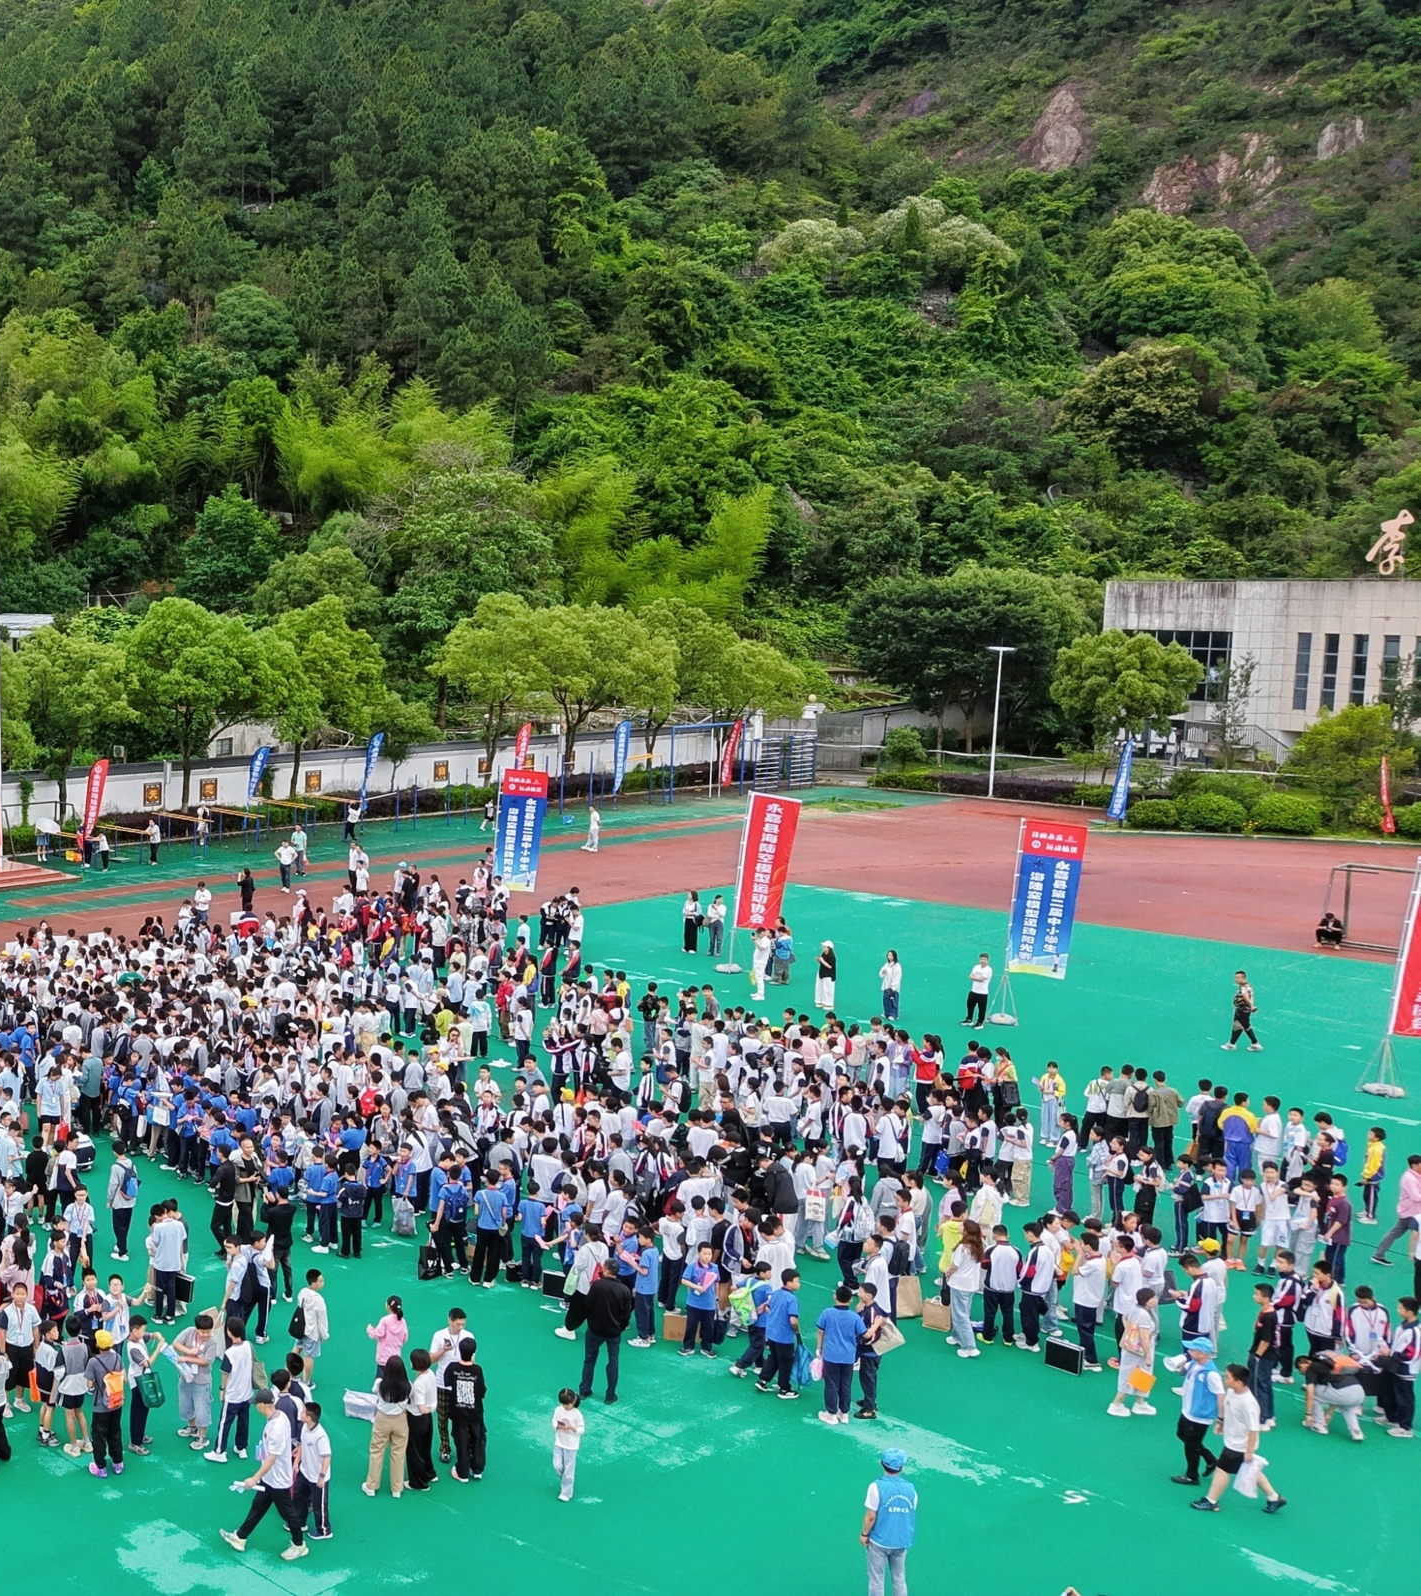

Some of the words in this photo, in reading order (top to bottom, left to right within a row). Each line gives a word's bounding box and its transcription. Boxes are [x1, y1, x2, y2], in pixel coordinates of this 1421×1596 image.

[1042, 860, 1071, 953] 永嘉县第二届中小学生
